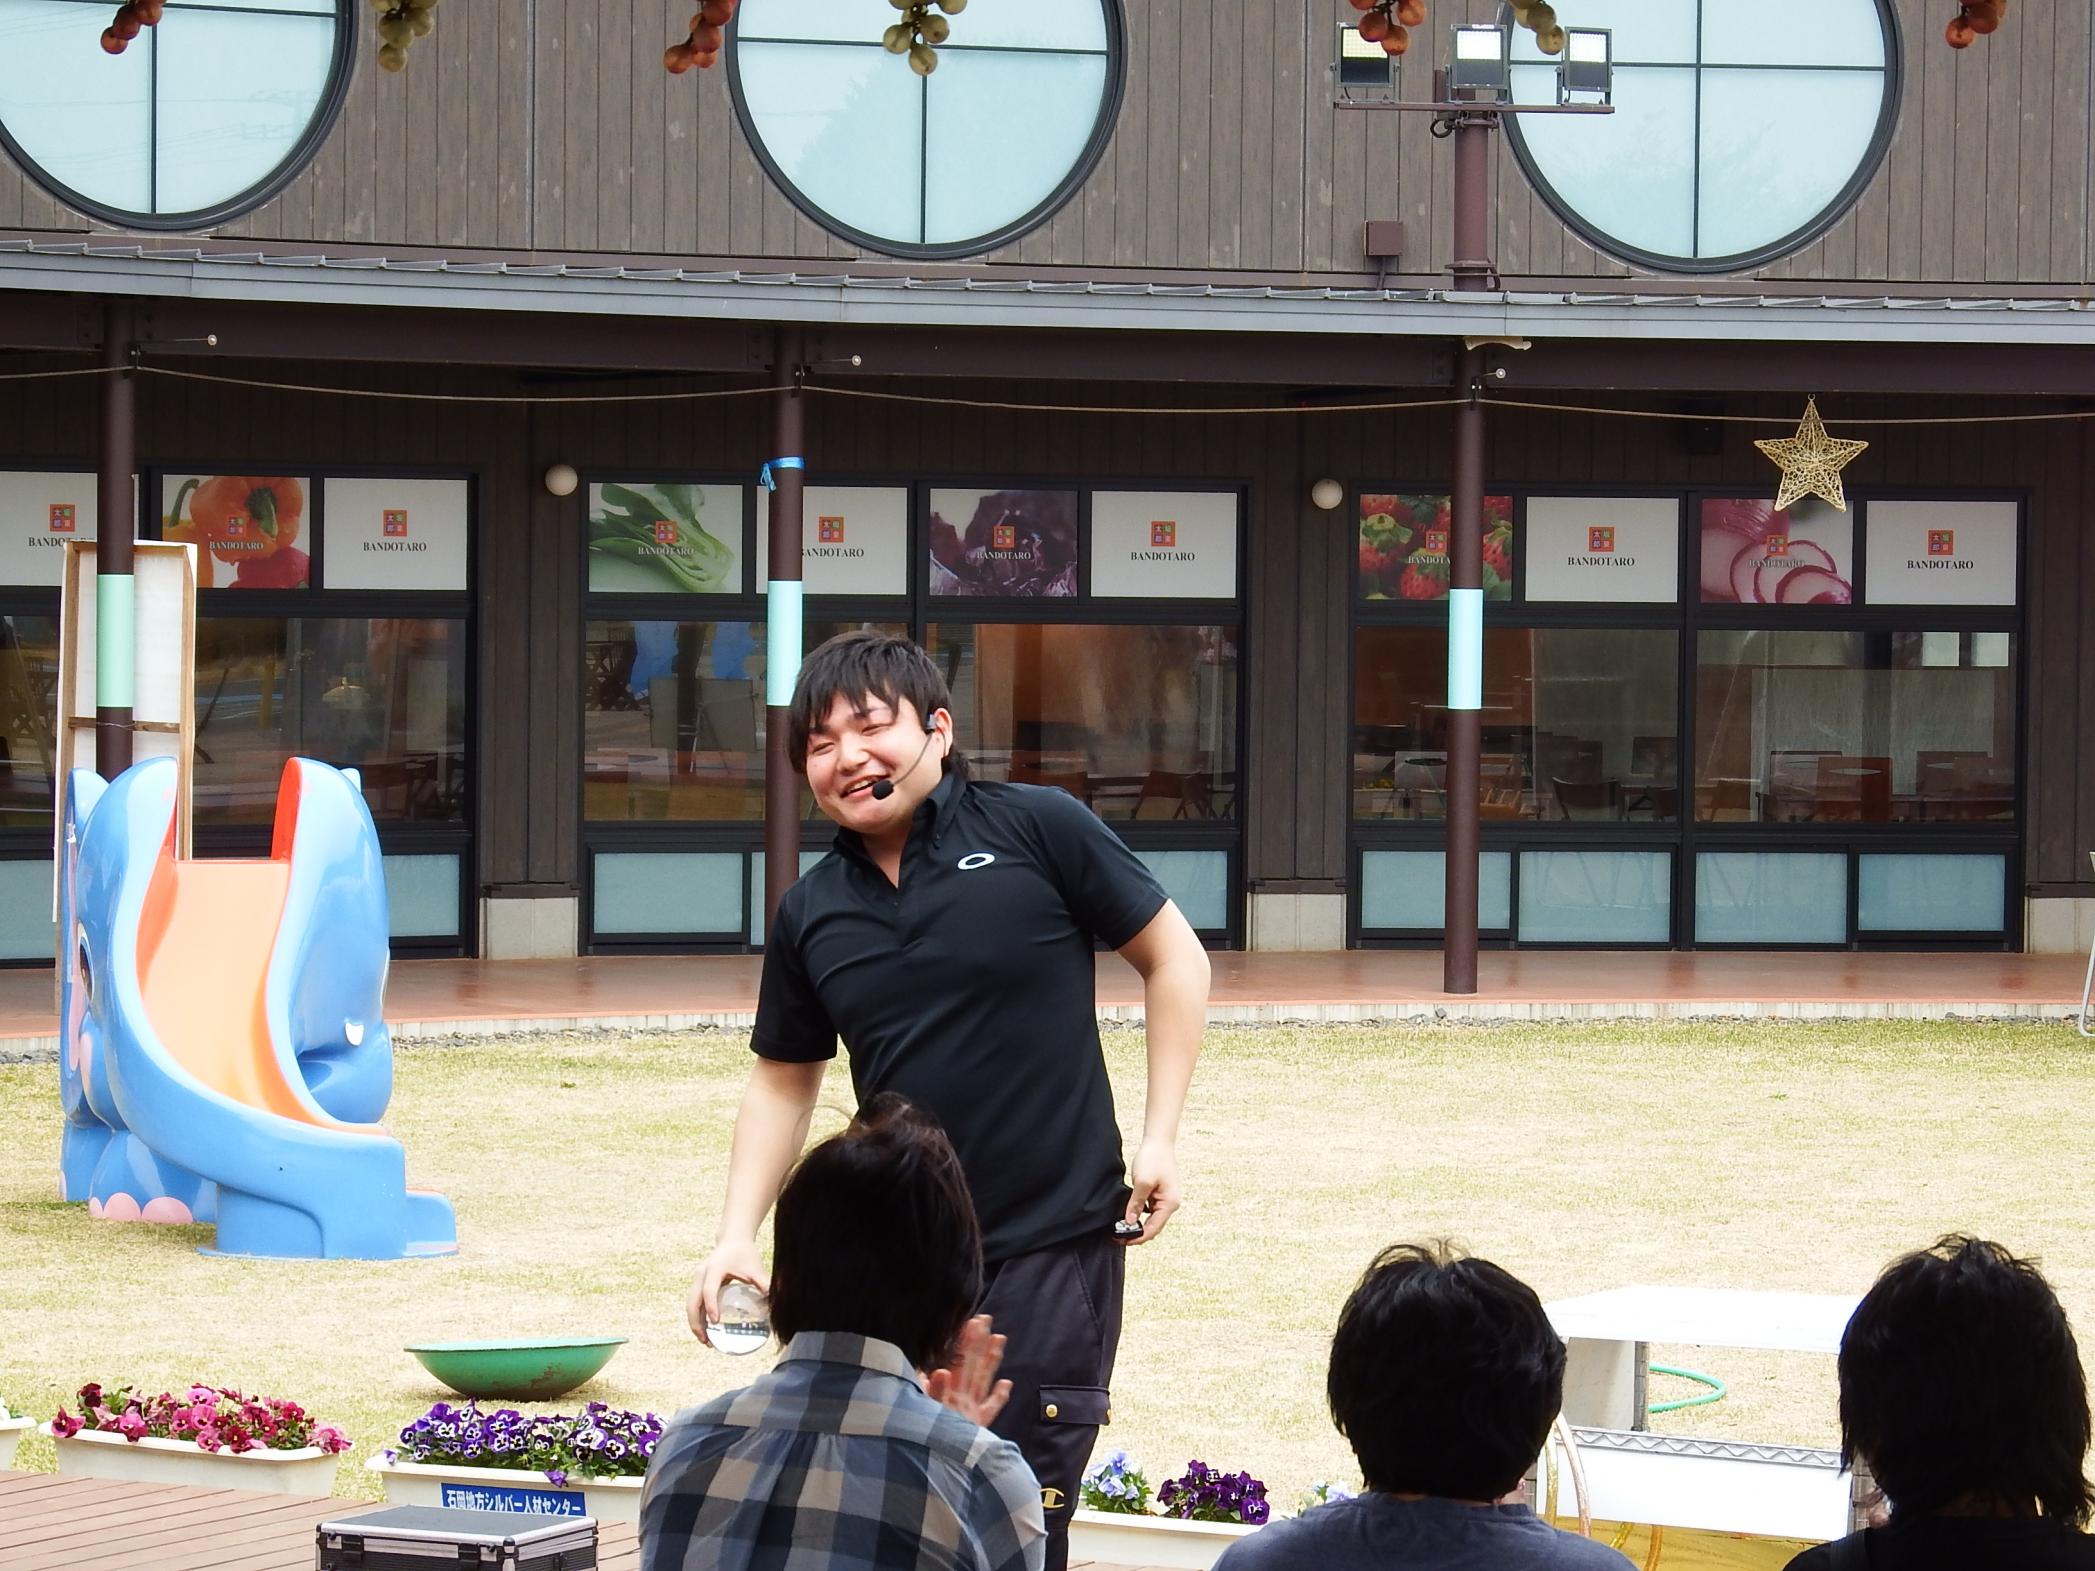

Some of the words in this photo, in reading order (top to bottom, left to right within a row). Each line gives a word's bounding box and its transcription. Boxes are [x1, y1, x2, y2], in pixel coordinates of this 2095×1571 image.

[209, 542, 264, 550] BANDOTARO
[363, 542, 427, 551] BANDOTARO
[638, 547, 694, 555] BANDOTARO
[977, 551, 1031, 560] BANDOTARO
[1131, 552, 1195, 561] BANDOTARO
[1568, 557, 1635, 566] BANDOTARO
[1907, 560, 1974, 569] BANDOTARO
